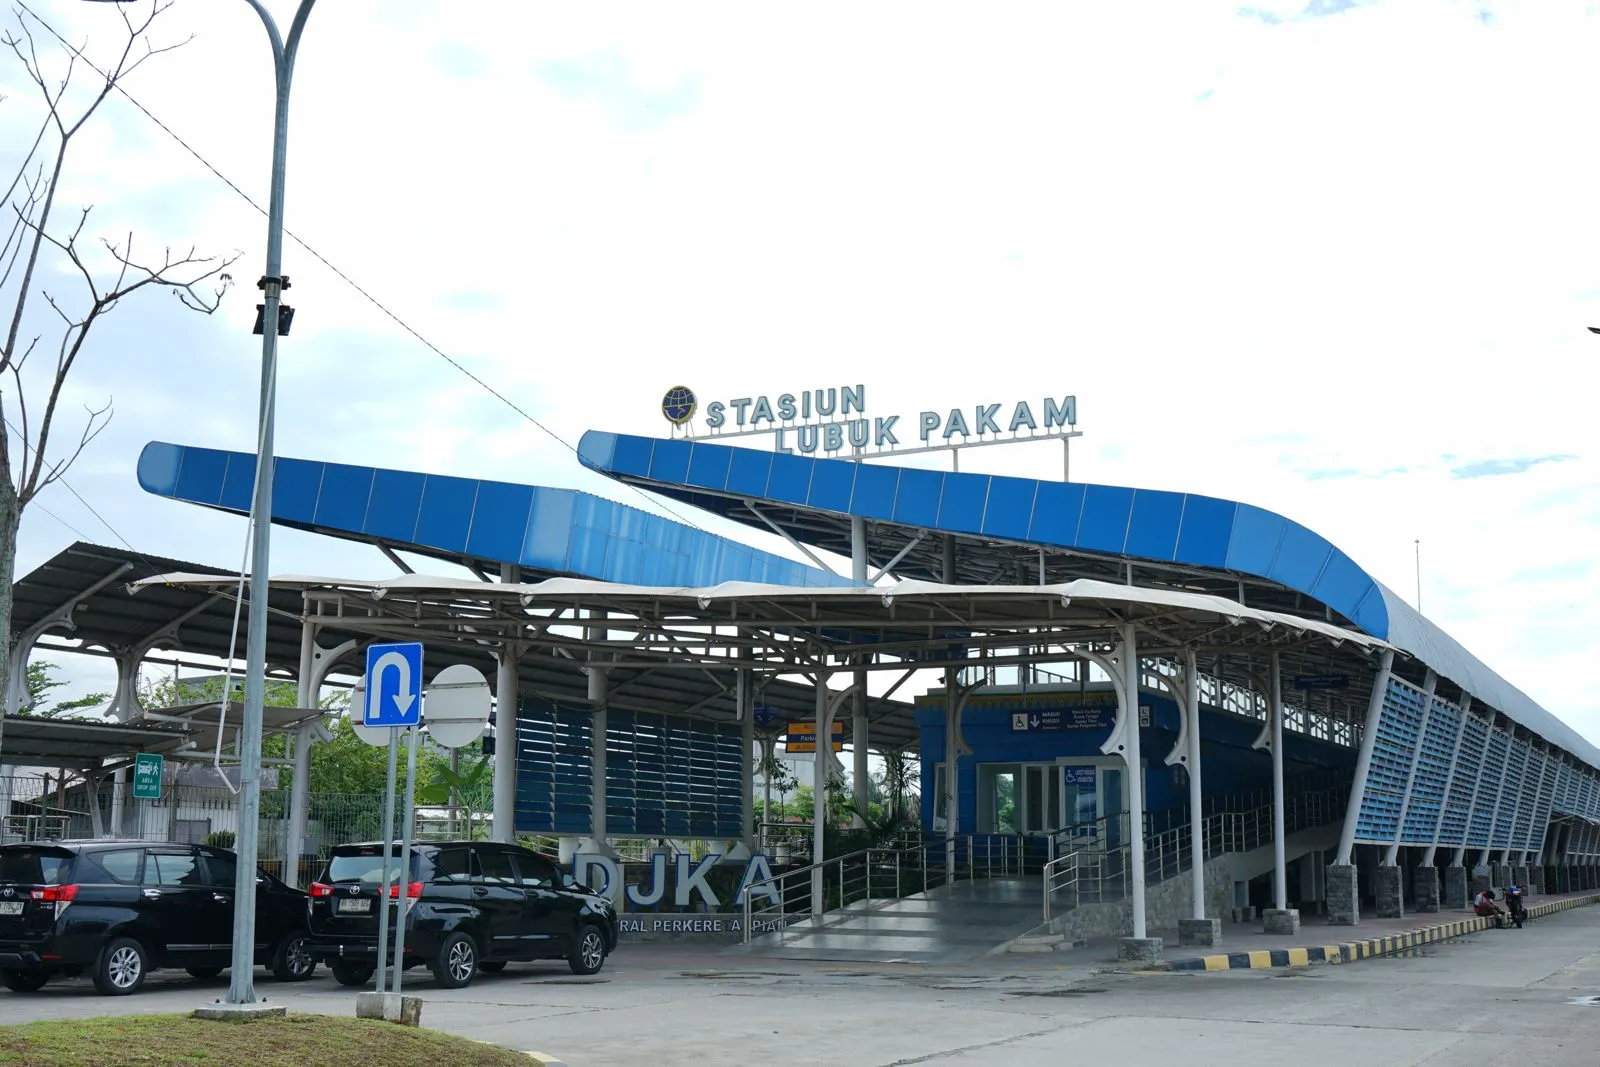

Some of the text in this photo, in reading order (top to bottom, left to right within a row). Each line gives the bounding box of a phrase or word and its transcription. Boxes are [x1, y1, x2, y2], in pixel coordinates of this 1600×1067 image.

[706, 384, 865, 427] STASIUN
[775, 395, 1076, 455] LUBUK PAKAM
[573, 853, 783, 906] DJKA
